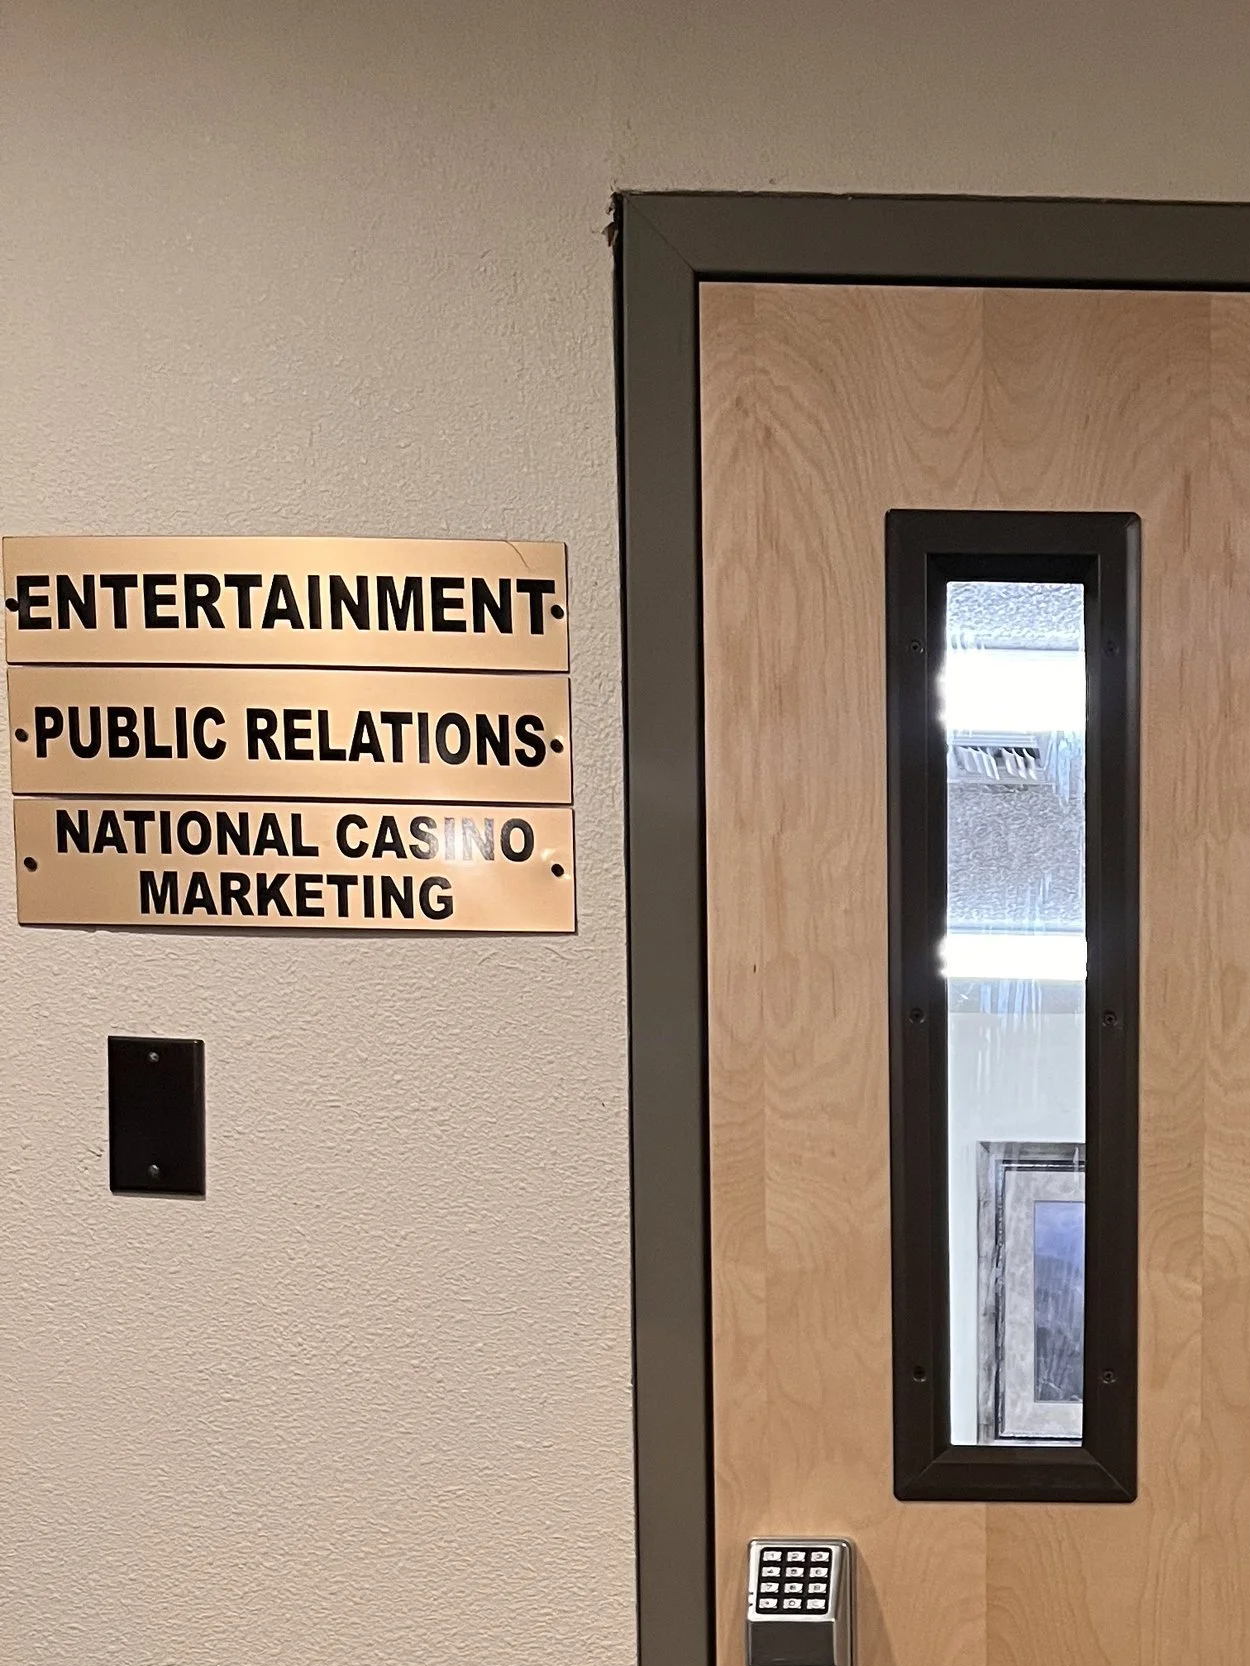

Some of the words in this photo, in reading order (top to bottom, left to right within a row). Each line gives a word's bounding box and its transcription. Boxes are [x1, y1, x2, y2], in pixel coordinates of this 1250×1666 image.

[15, 573, 556, 635] ENTERTAINMENT
[34, 706, 227, 760] PUBLIC
[246, 707, 547, 768] RELATIONS
[55, 809, 320, 857] NATIONAL
[336, 814, 535, 863] CASINO
[139, 870, 454, 920] MARKETING
